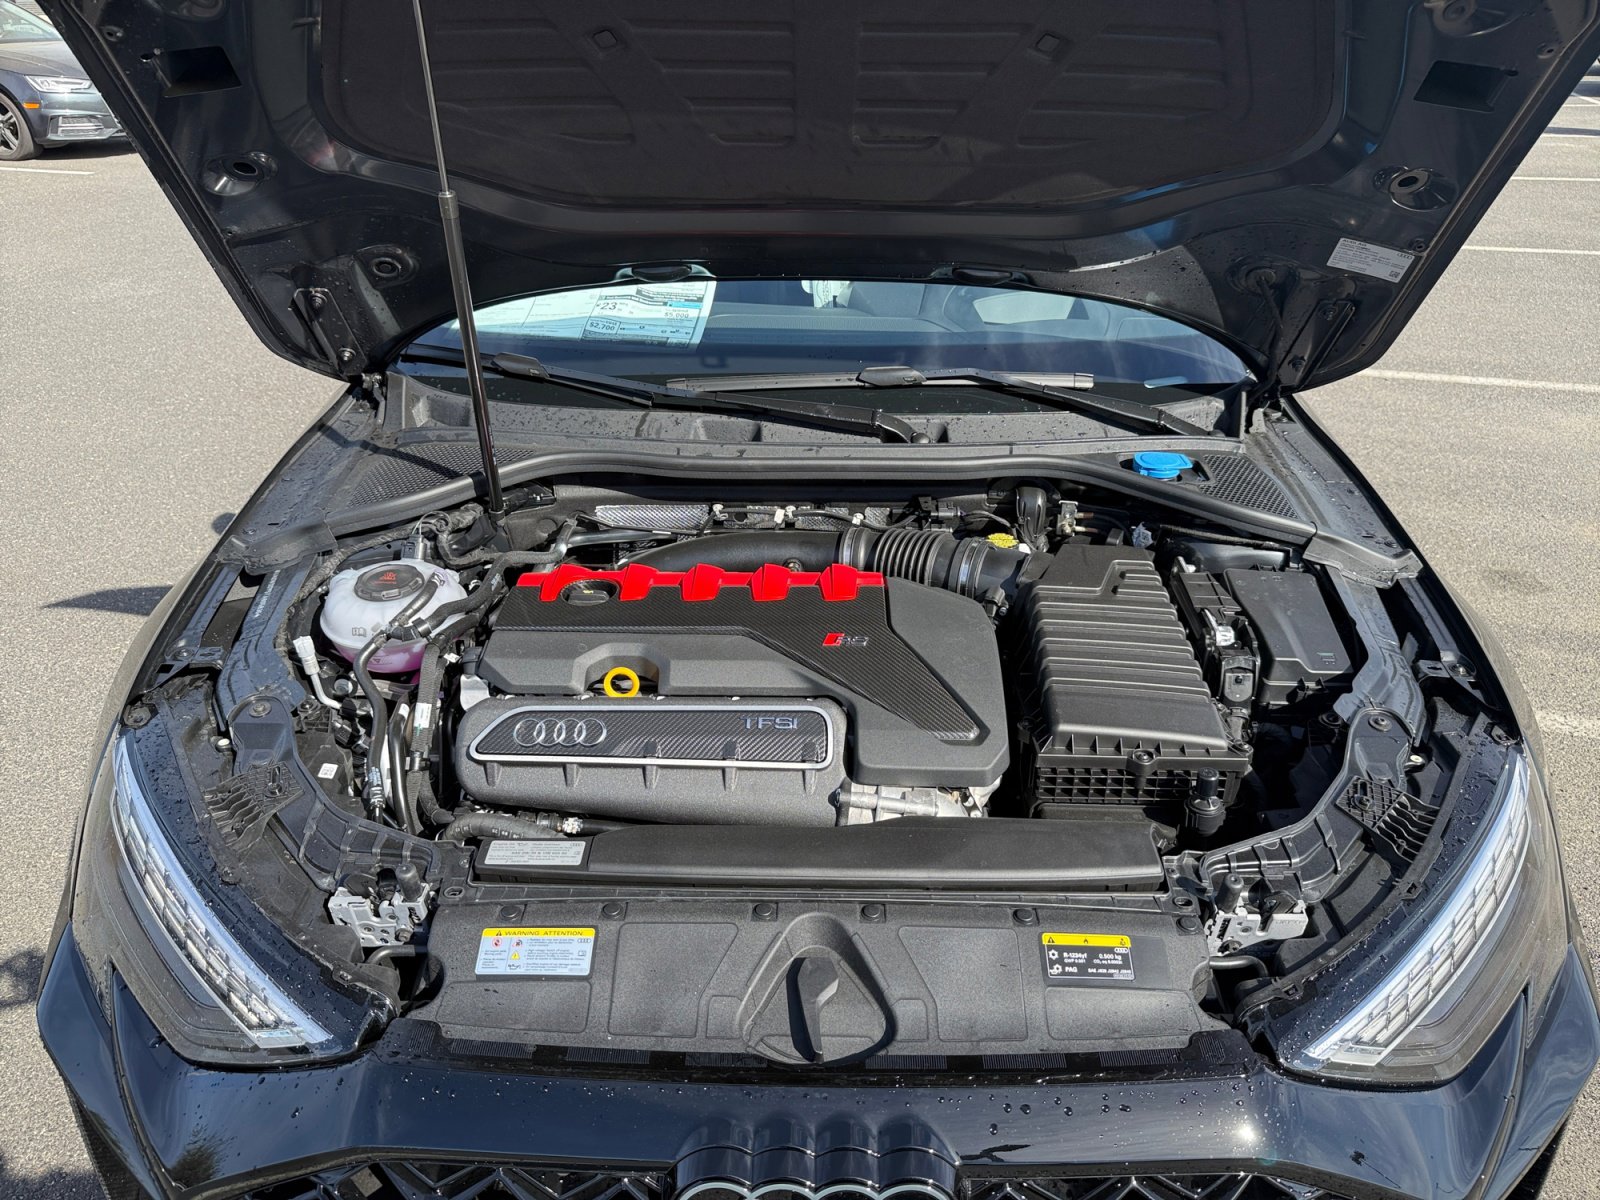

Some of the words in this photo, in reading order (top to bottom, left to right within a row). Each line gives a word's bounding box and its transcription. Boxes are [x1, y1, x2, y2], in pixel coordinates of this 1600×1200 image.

[600, 302, 617, 311] 23
[589, 321, 615, 331] $2,700
[740, 716, 798, 730] TFSI
